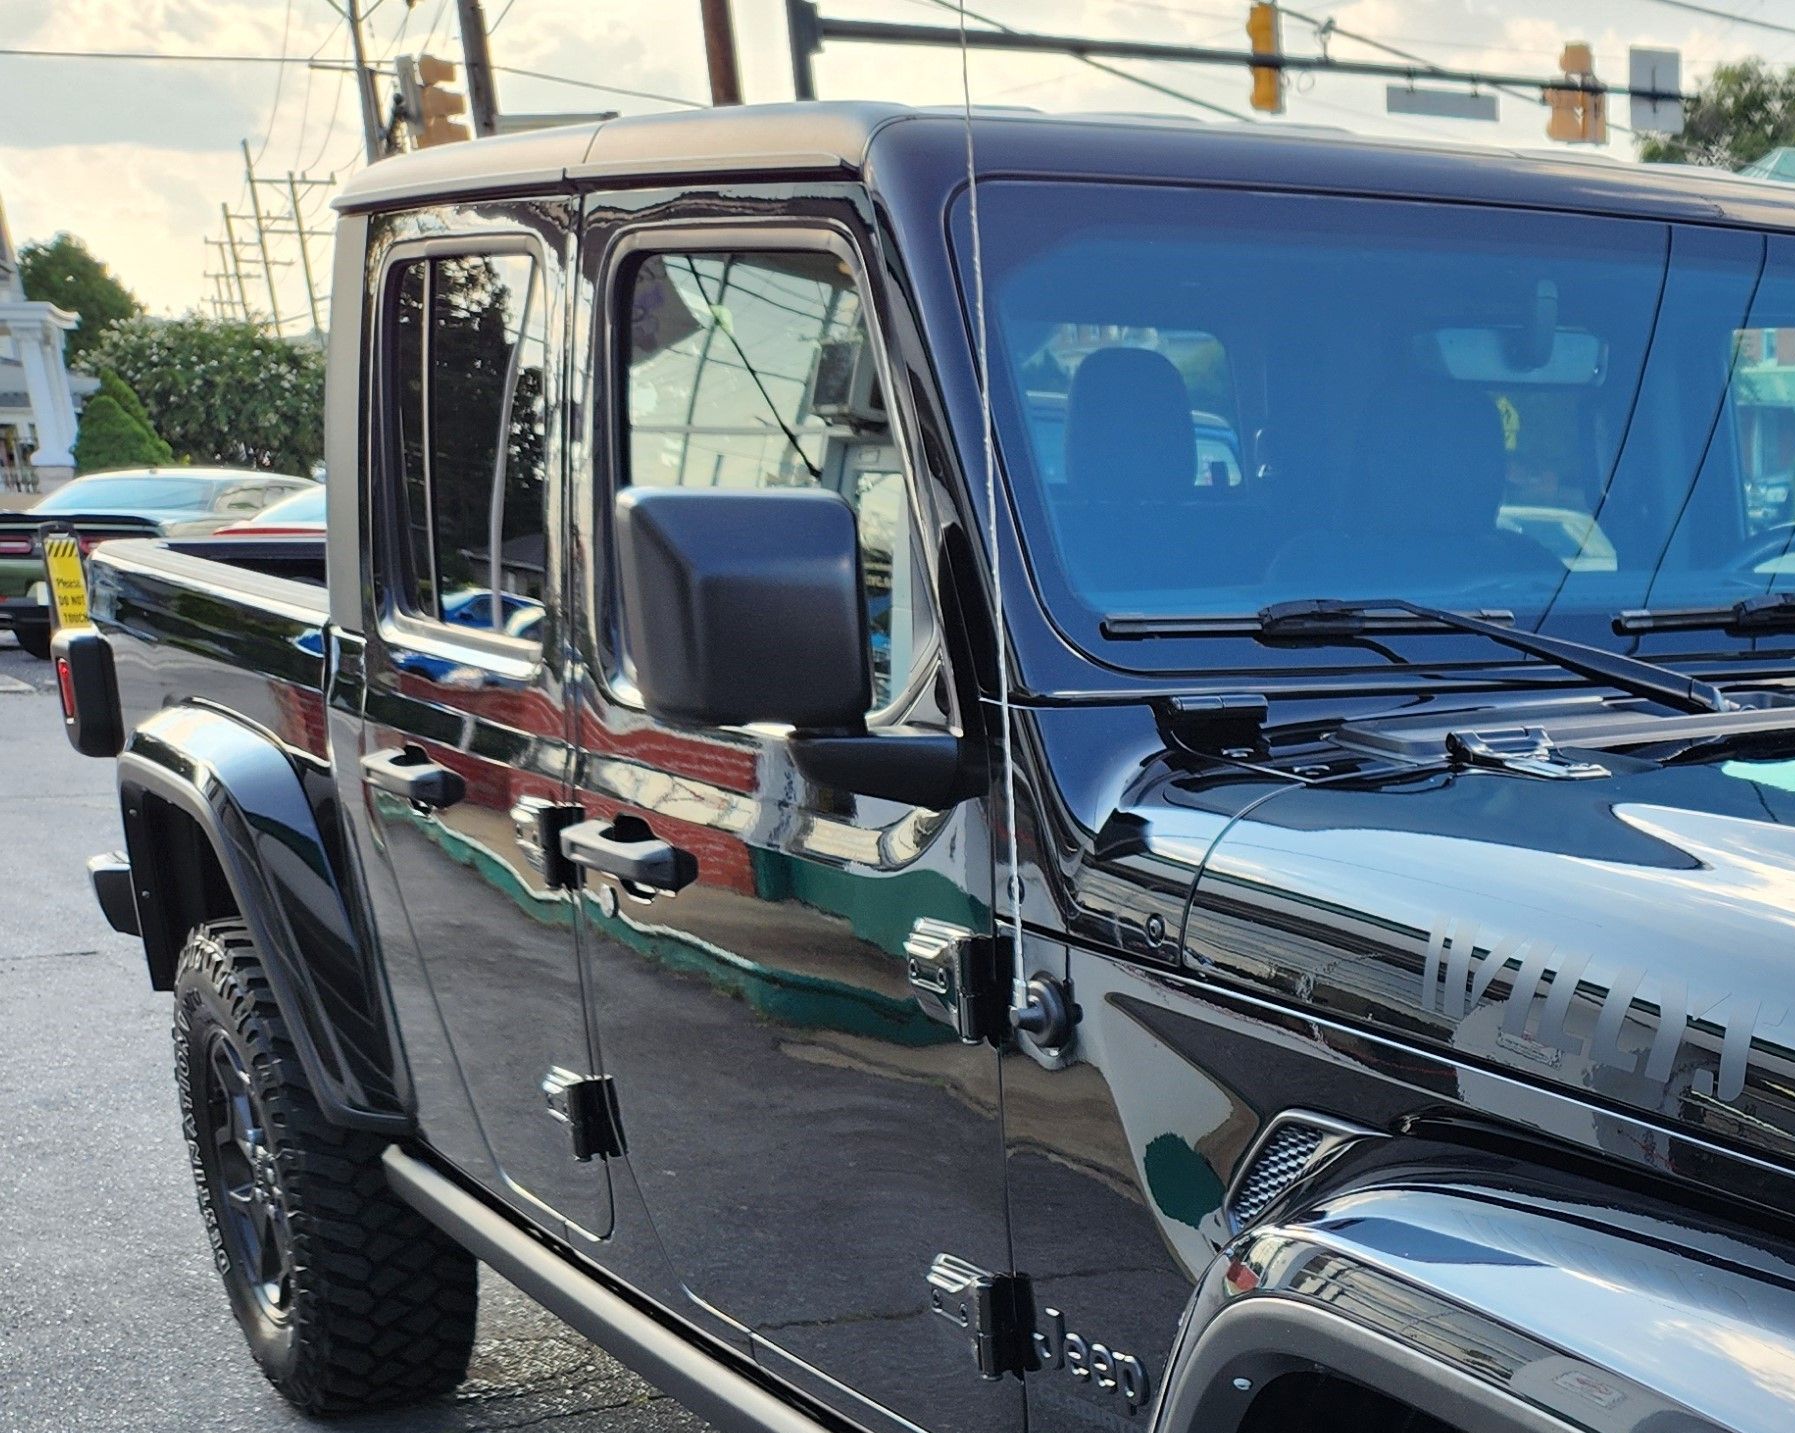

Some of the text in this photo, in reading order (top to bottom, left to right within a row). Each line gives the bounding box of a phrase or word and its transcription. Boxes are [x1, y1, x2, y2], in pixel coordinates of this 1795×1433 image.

[58, 594, 85, 606] DO NOT
[1032, 1307, 1150, 1416] Jeep
